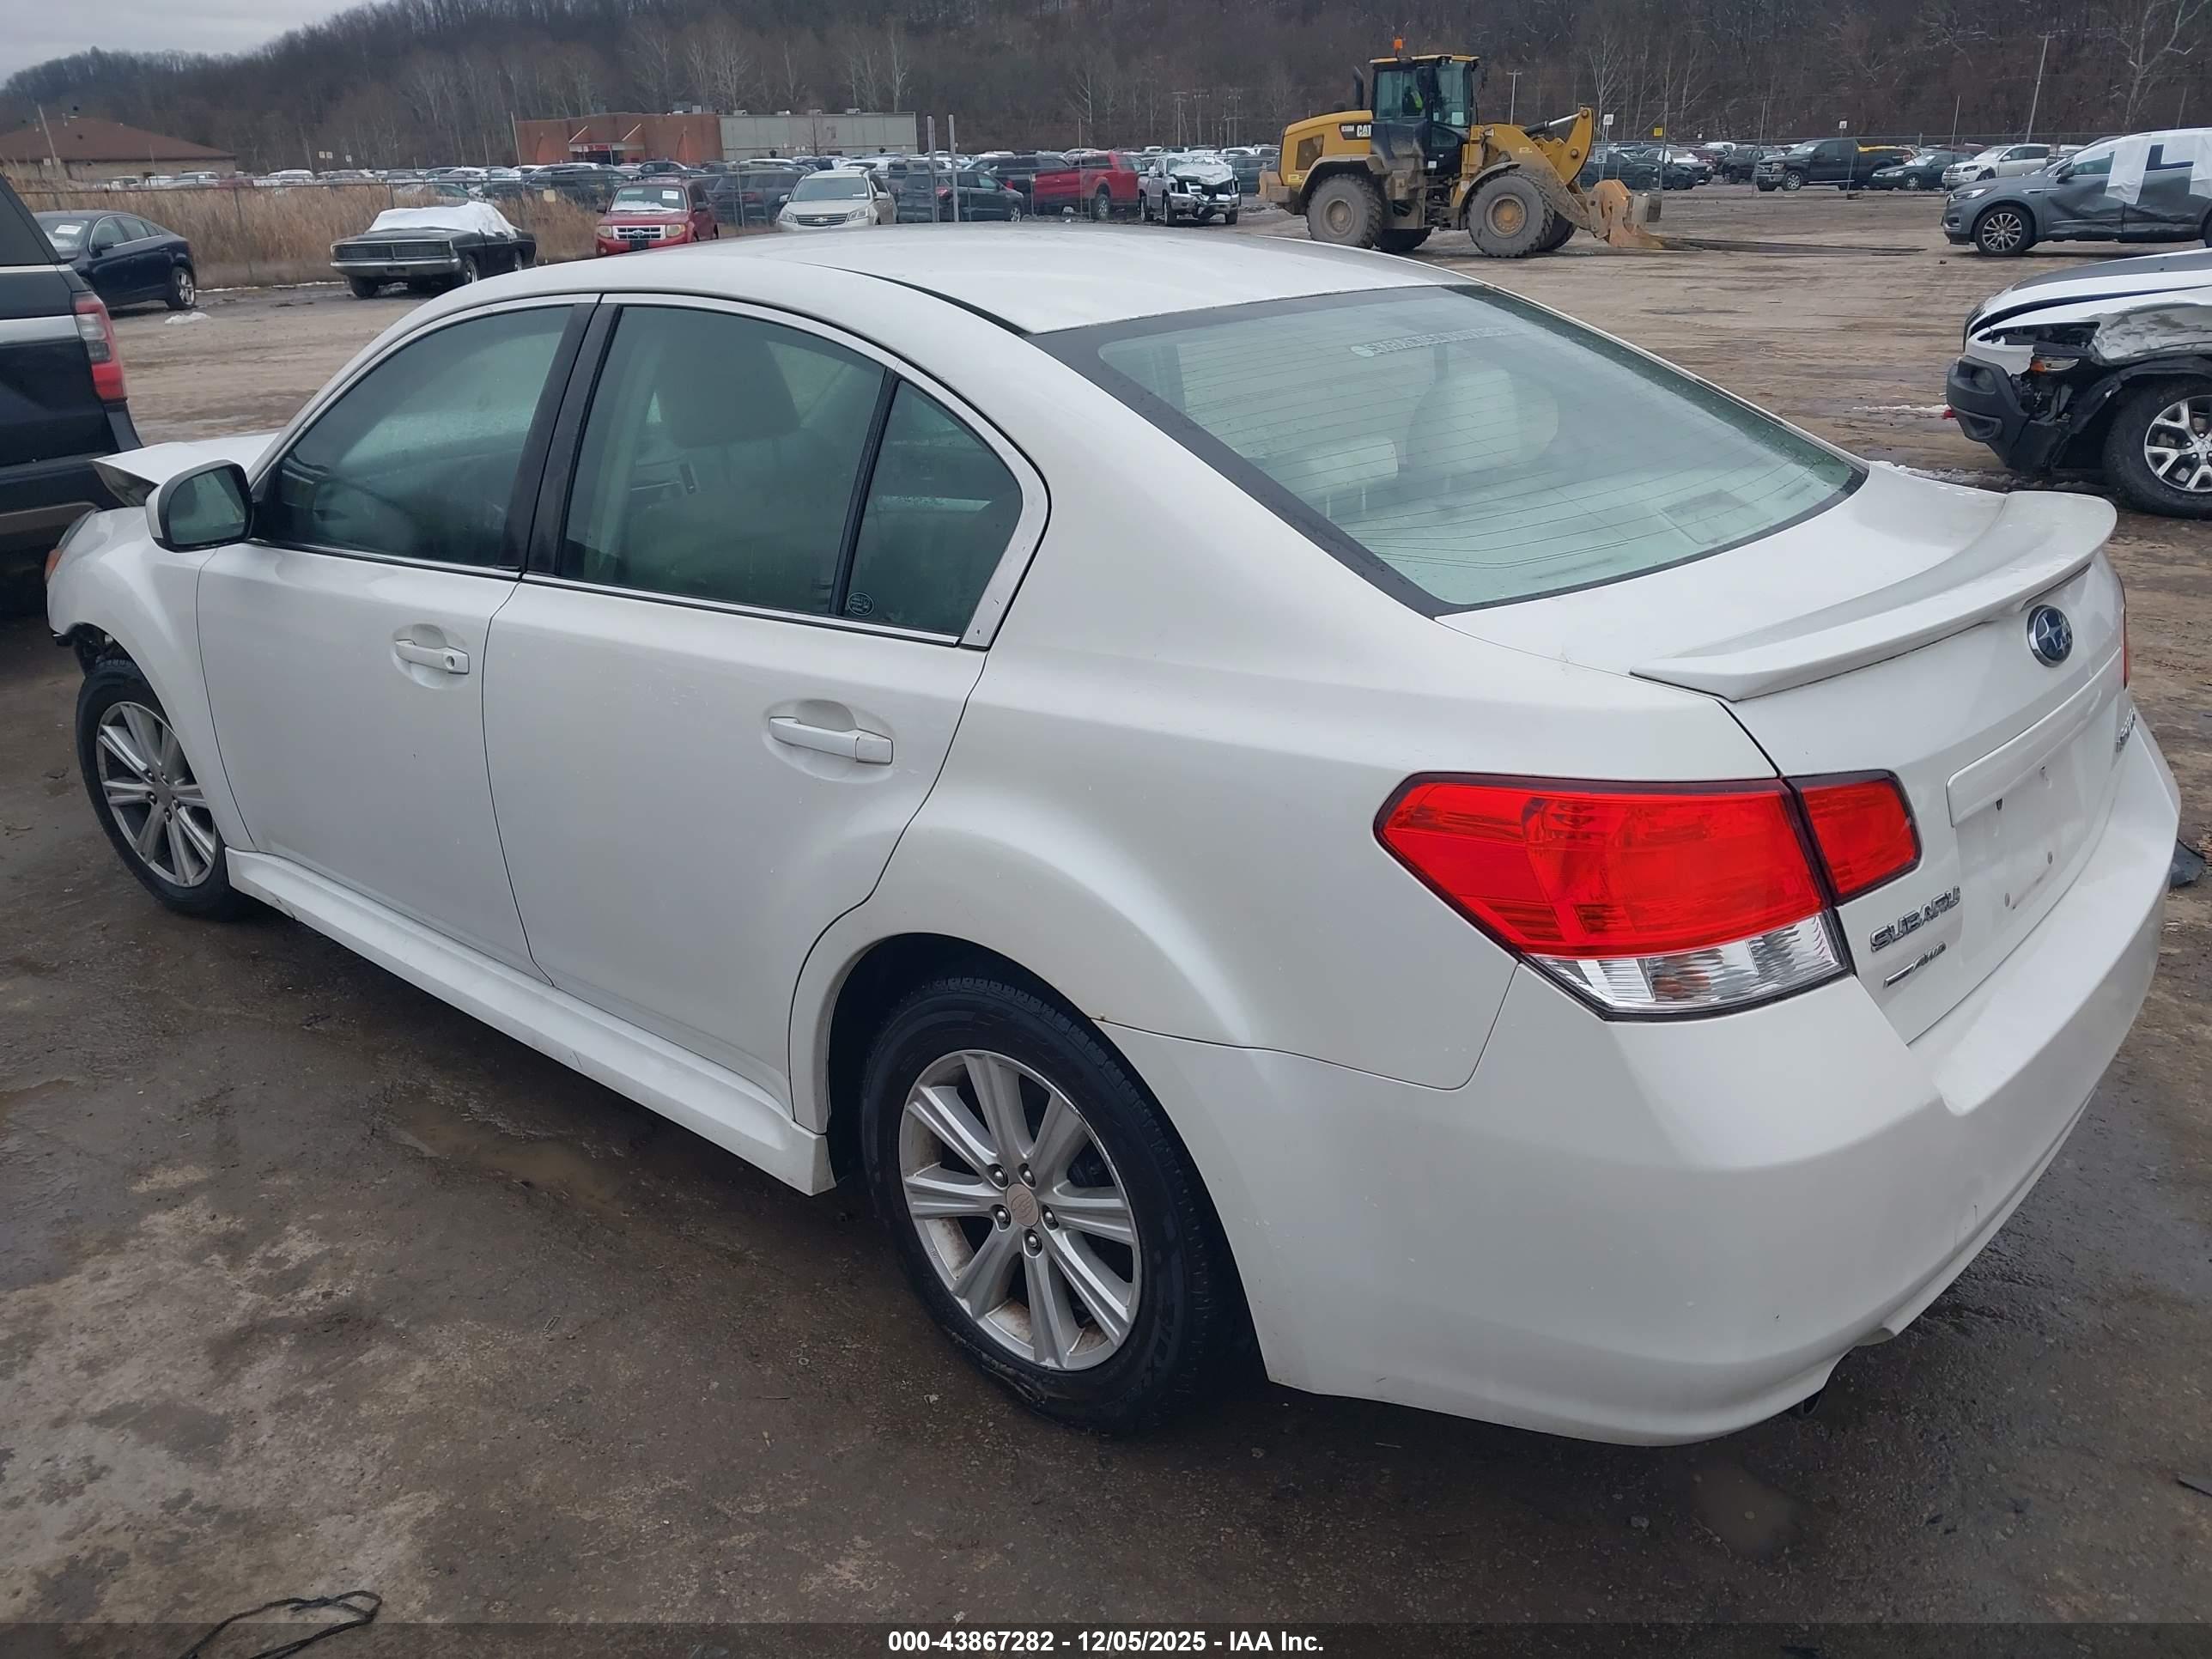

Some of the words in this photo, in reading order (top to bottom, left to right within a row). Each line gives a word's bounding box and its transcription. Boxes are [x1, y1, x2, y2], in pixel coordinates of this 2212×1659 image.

[1357, 125, 1371, 137] CAT
[1869, 885, 1961, 953] SUBARU
[1912, 941, 1947, 972] AWD
